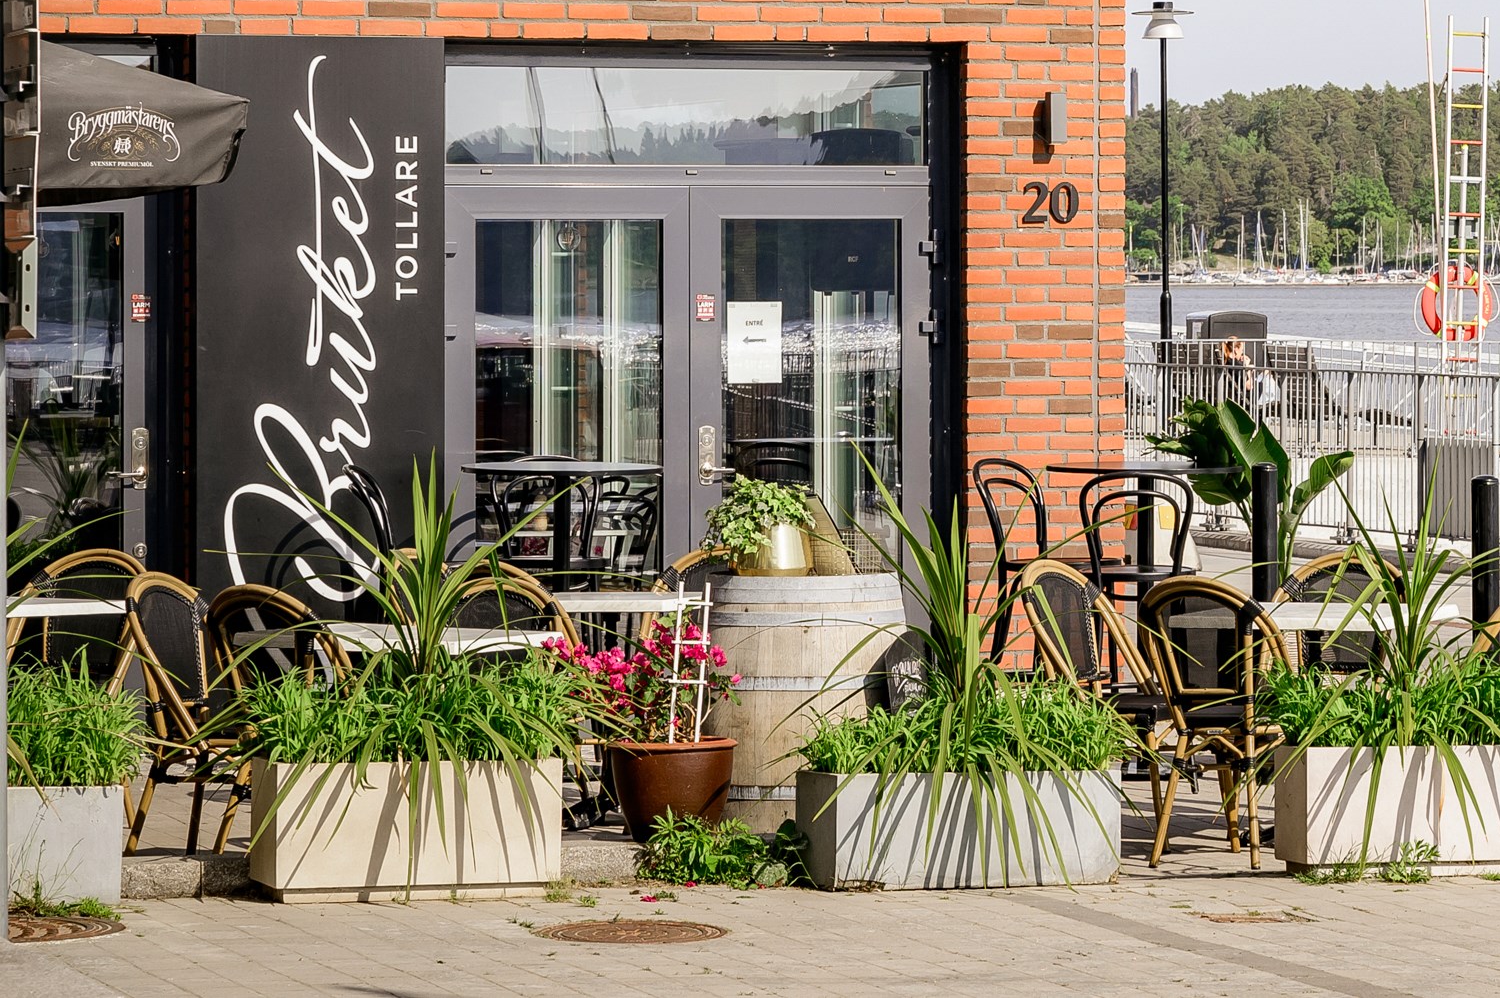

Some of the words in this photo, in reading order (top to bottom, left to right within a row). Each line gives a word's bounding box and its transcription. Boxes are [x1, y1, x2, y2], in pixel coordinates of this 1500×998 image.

[67, 101, 181, 162] Bryggmästarens
[117, 159, 154, 167] PREMIUMÖL
[395, 135, 419, 301] TOLLARE
[1022, 181, 1079, 224] 20
[745, 319, 764, 327] ENTRÉ
[223, 55, 381, 690] Bruket
